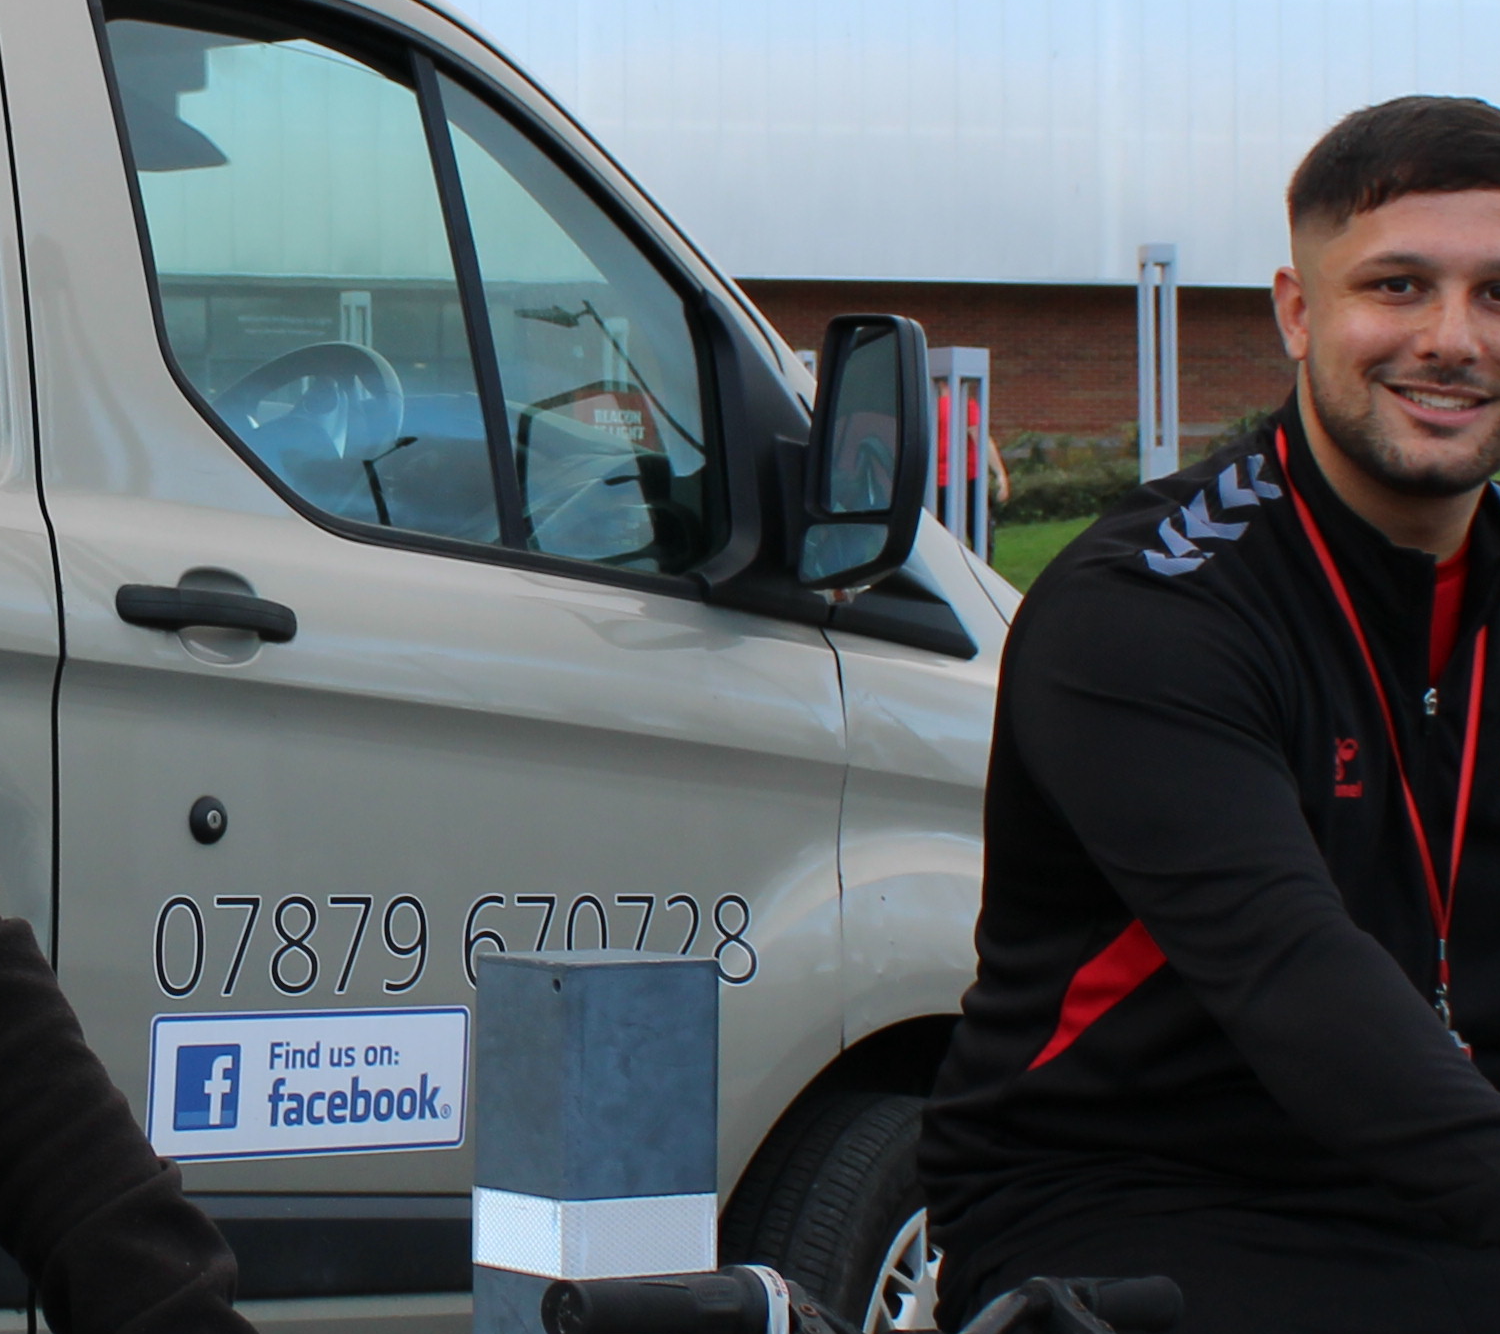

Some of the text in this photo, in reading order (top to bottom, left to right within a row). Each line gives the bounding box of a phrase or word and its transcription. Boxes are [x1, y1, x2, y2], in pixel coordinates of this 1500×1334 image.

[153, 893, 430, 1000] 07879
[268, 1041, 401, 1071] Find us on:
[268, 1073, 441, 1127] facebook
